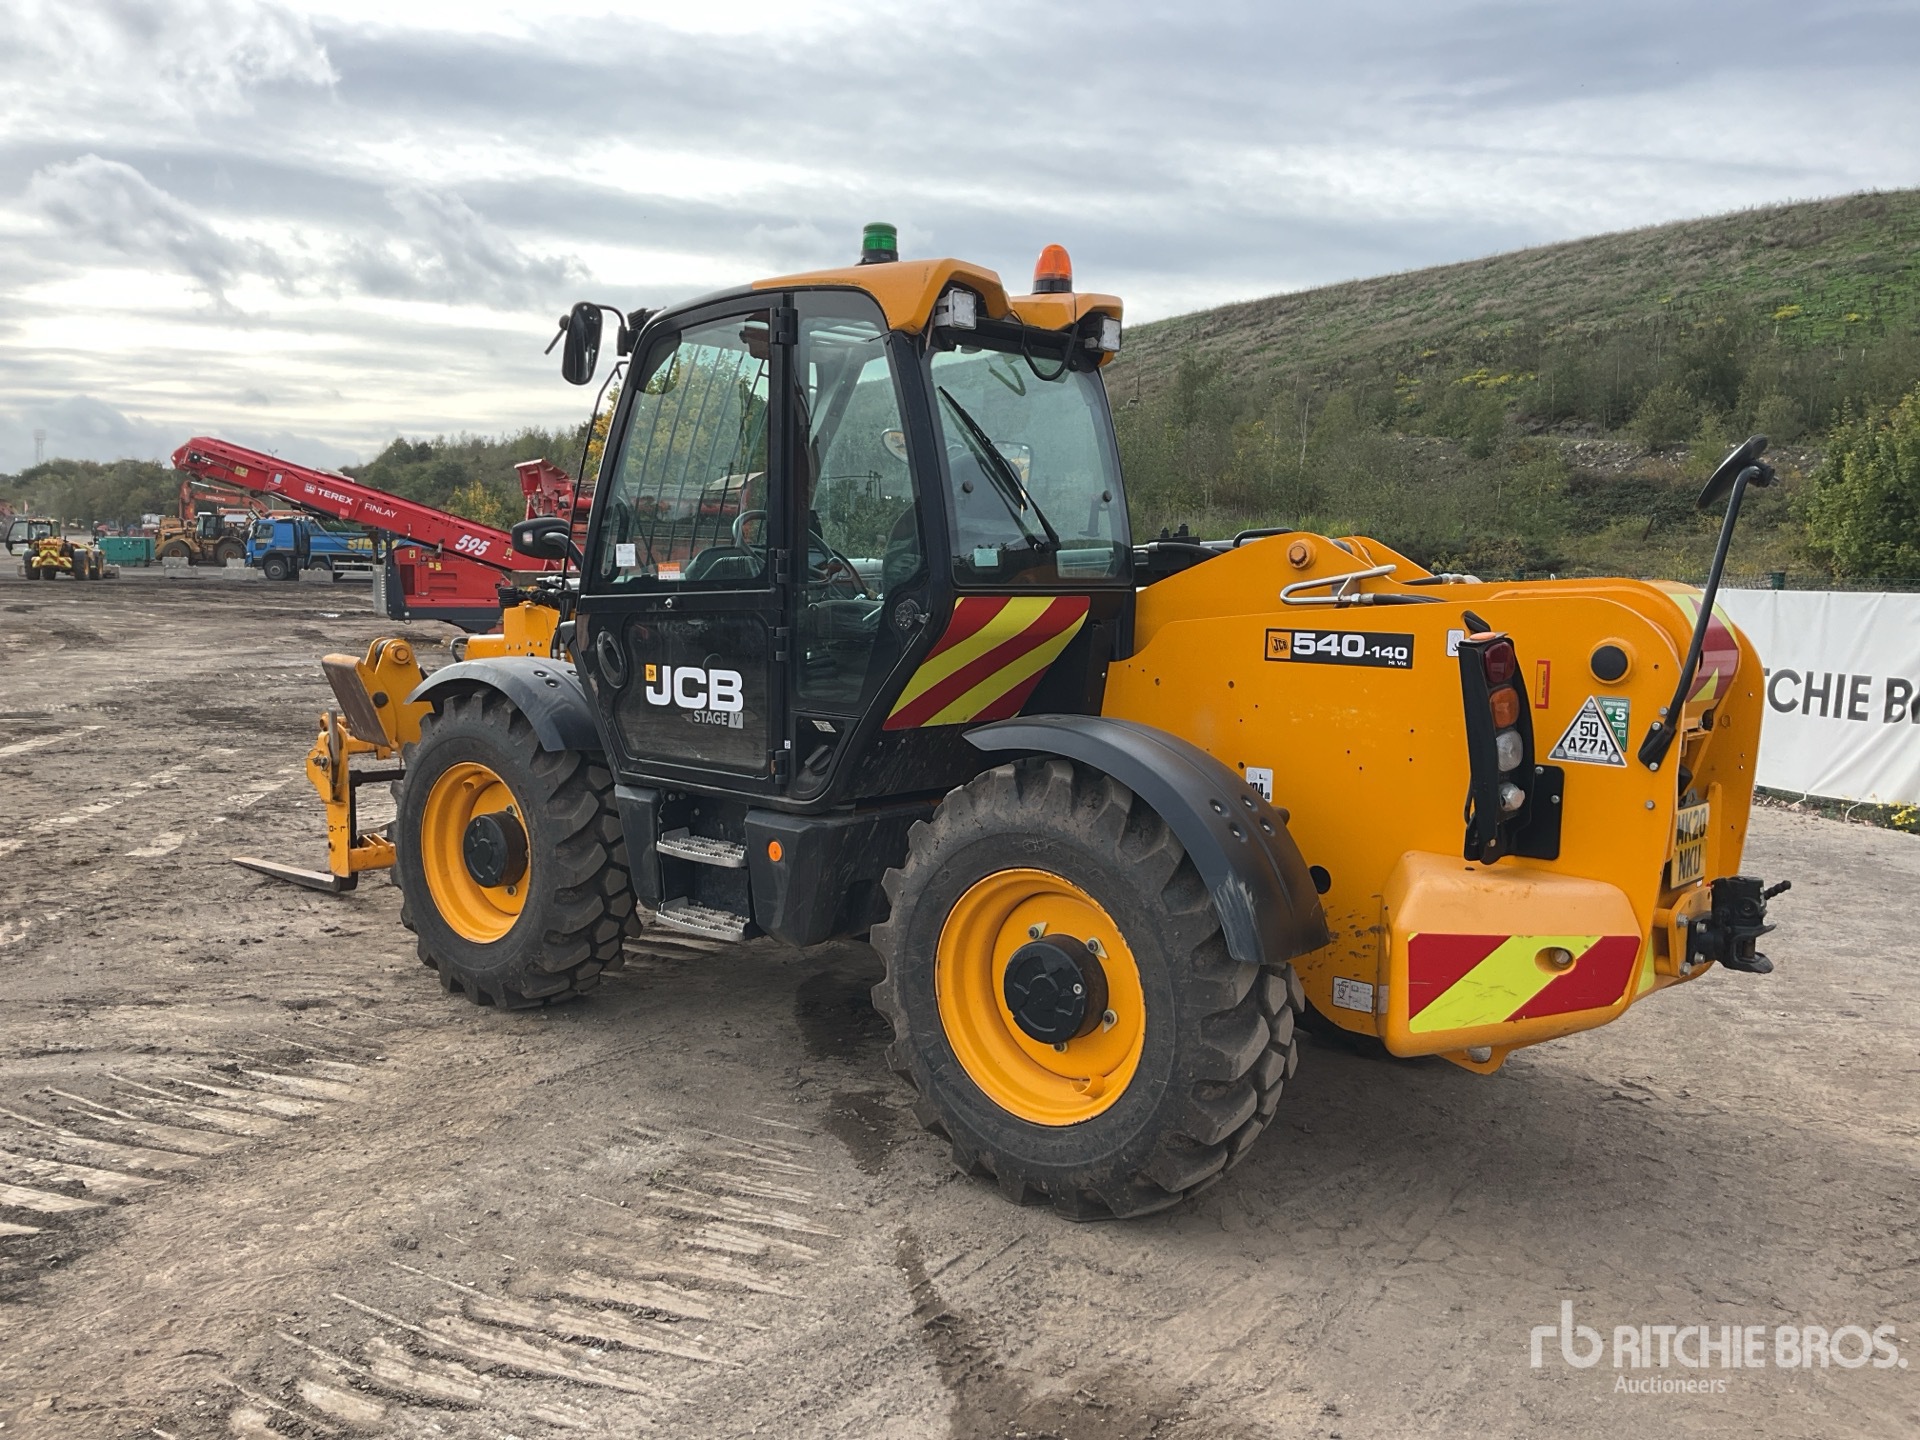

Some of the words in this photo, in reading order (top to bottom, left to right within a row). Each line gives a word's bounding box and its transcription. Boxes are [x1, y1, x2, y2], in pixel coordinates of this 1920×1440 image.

[318, 488, 353, 505] TEREX
[364, 502, 397, 518] FINLAY
[455, 534, 491, 556] 595
[1293, 632, 1408, 660] 540-140
[645, 665, 743, 712] JCB
[1764, 668, 1872, 721] CHIE
[693, 710, 727, 725] STAGE
[1614, 707, 1626, 721] 5
[1568, 736, 1608, 755] AZ7A
[1678, 843, 1702, 881] NKU
